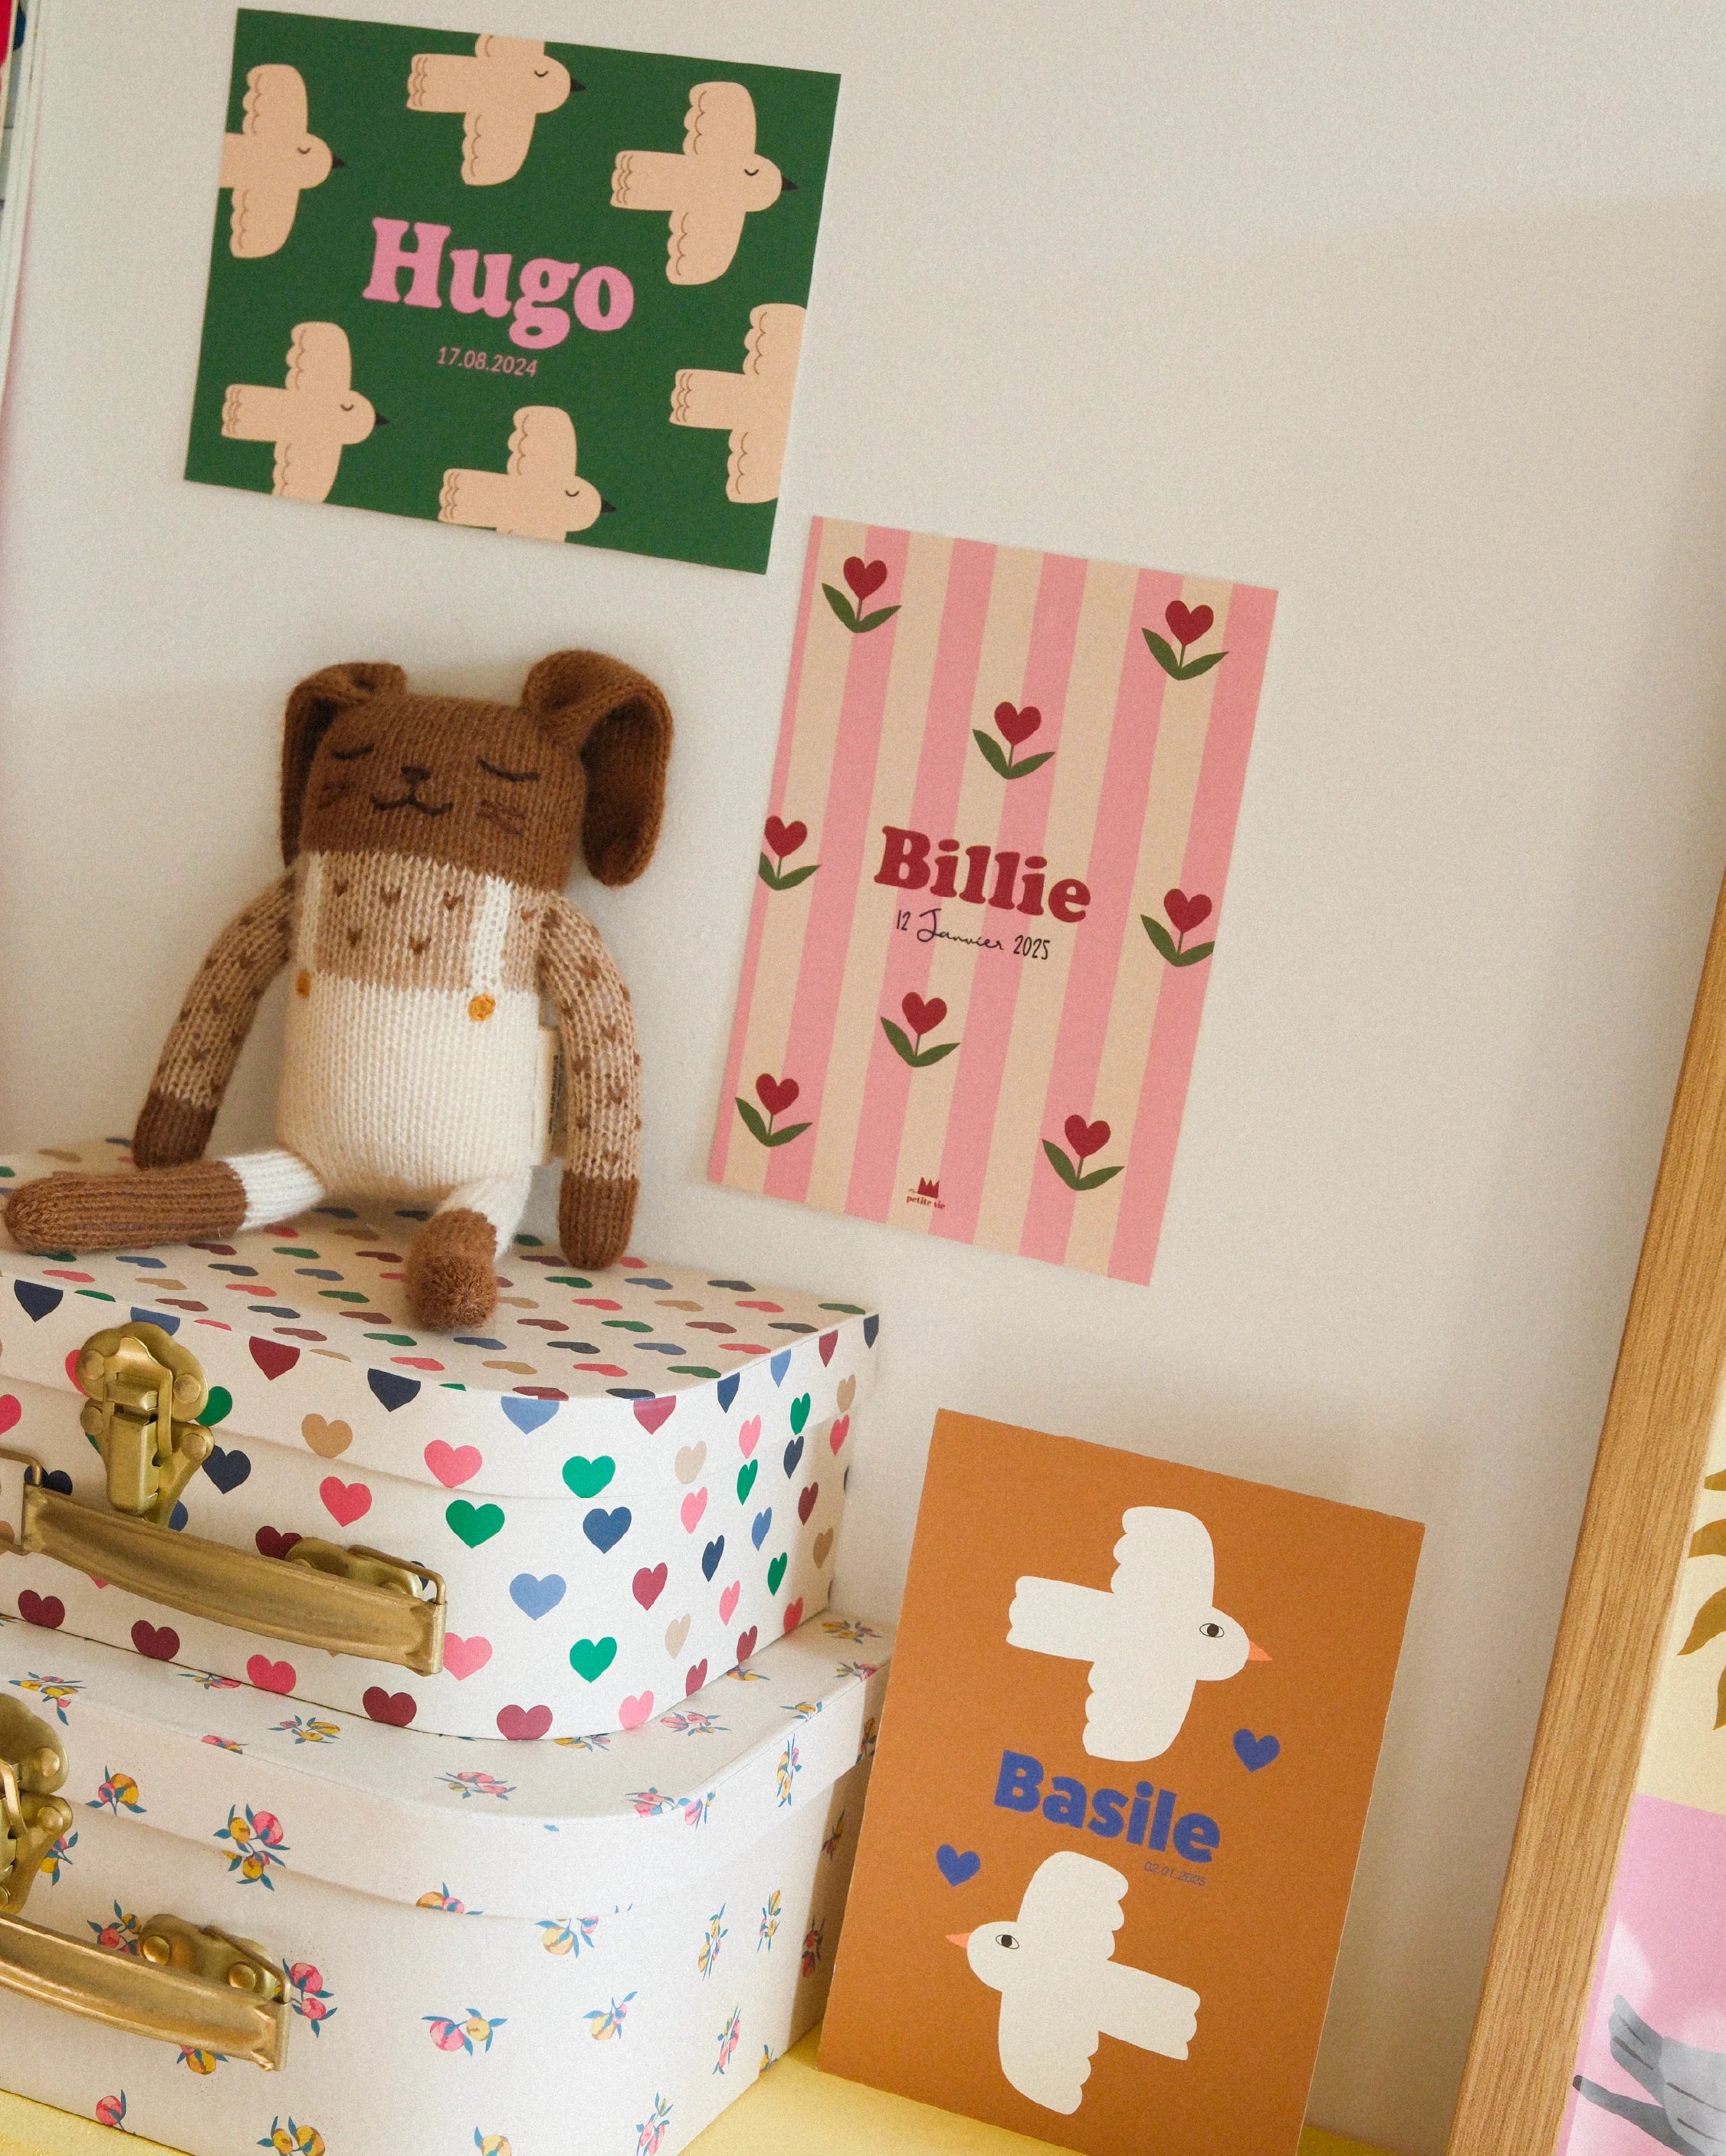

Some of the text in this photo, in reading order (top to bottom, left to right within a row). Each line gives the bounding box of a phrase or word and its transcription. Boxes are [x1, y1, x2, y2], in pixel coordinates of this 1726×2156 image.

[362, 217, 635, 349] Hugo
[438, 347, 537, 377] 17.08.2024
[874, 825, 1091, 923] Billie
[896, 908, 1051, 960] 12 Janvier 2025
[907, 1196, 931, 1206] petite
[993, 1749, 1220, 1863] Basile
[1144, 1861, 1206, 1886] 02.01.2025
